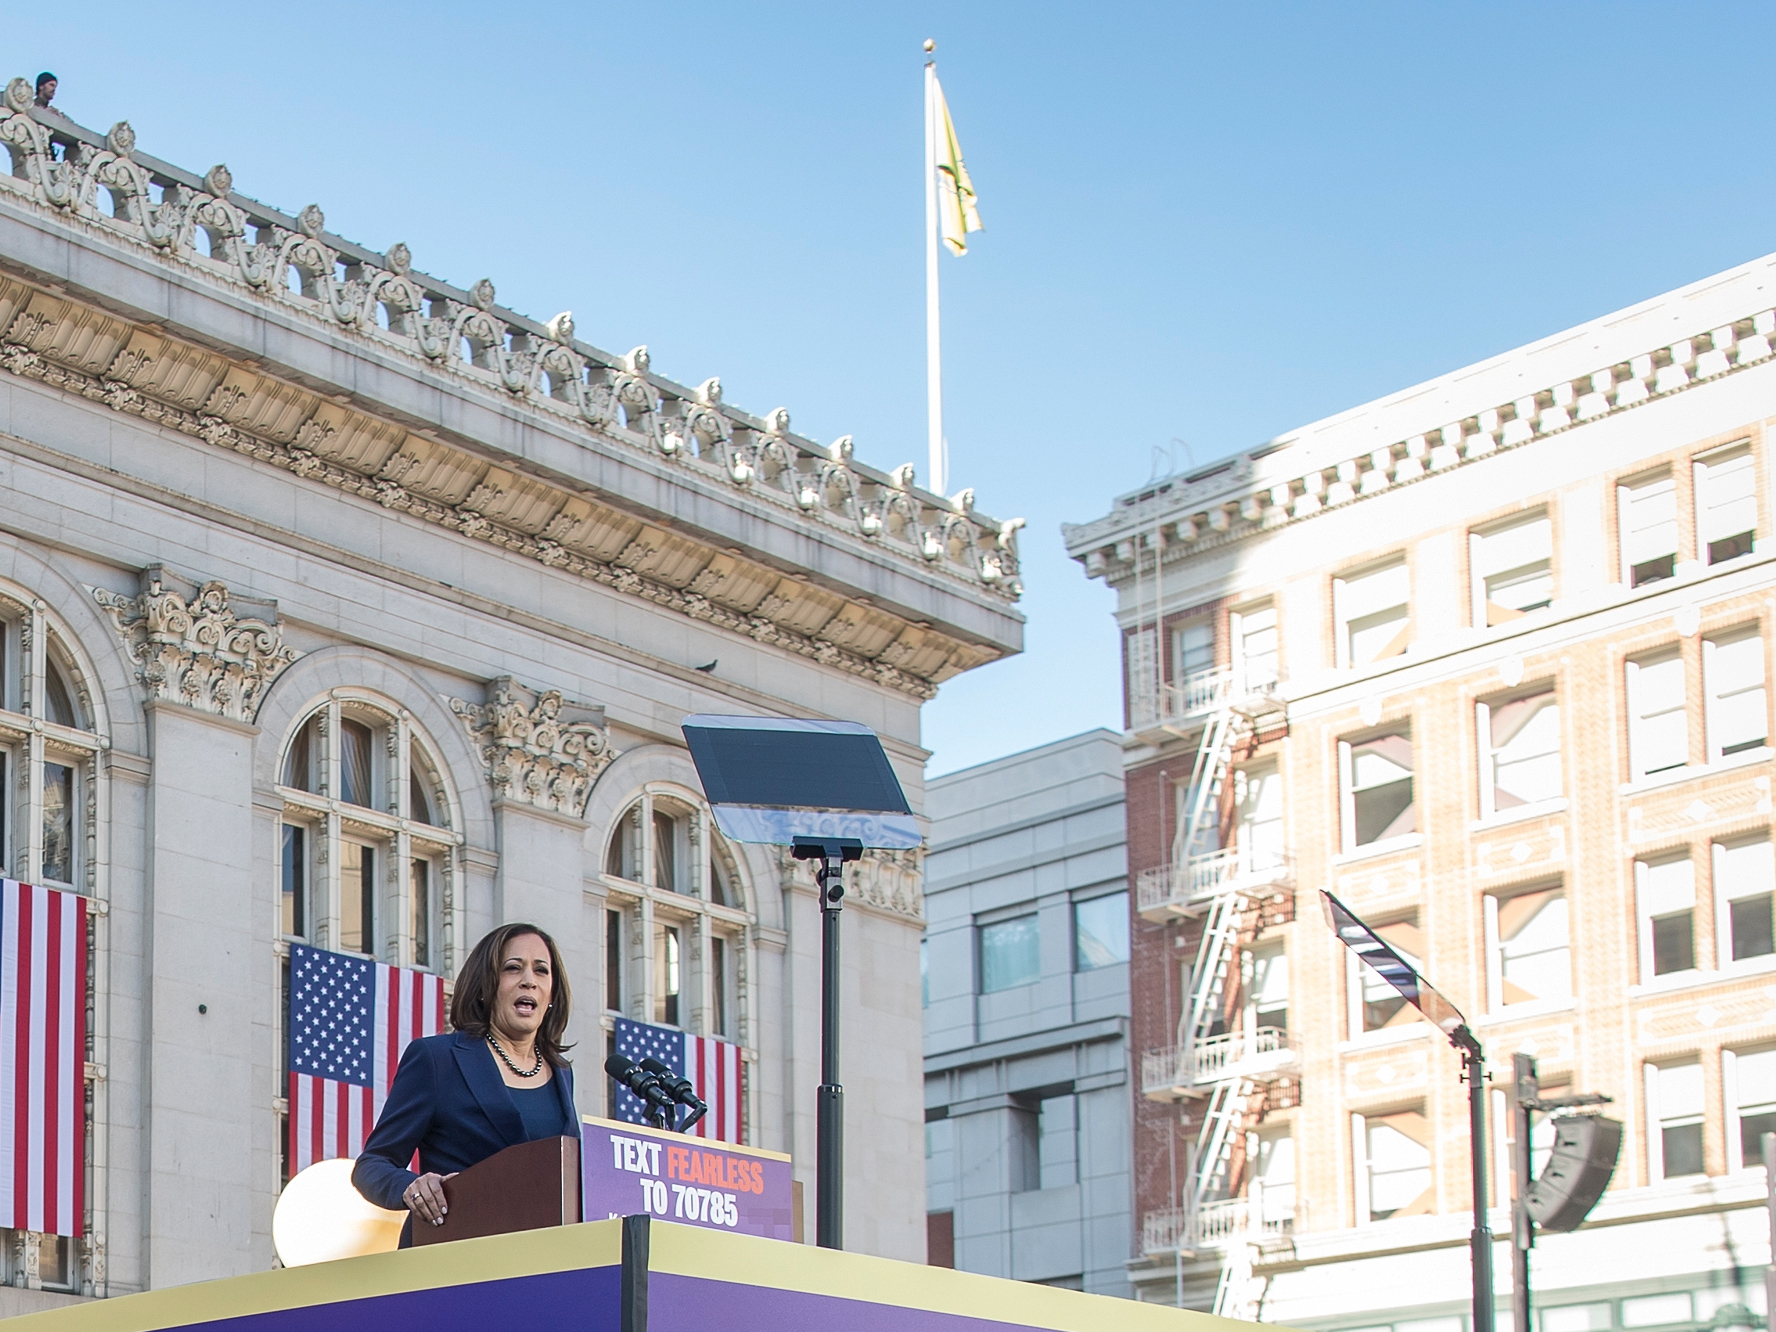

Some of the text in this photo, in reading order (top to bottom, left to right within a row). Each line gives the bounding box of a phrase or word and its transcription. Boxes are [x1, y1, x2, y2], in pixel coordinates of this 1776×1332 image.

[610, 1134, 764, 1195] TEXT FEARLESS
[640, 1178, 738, 1227] TO 70785
